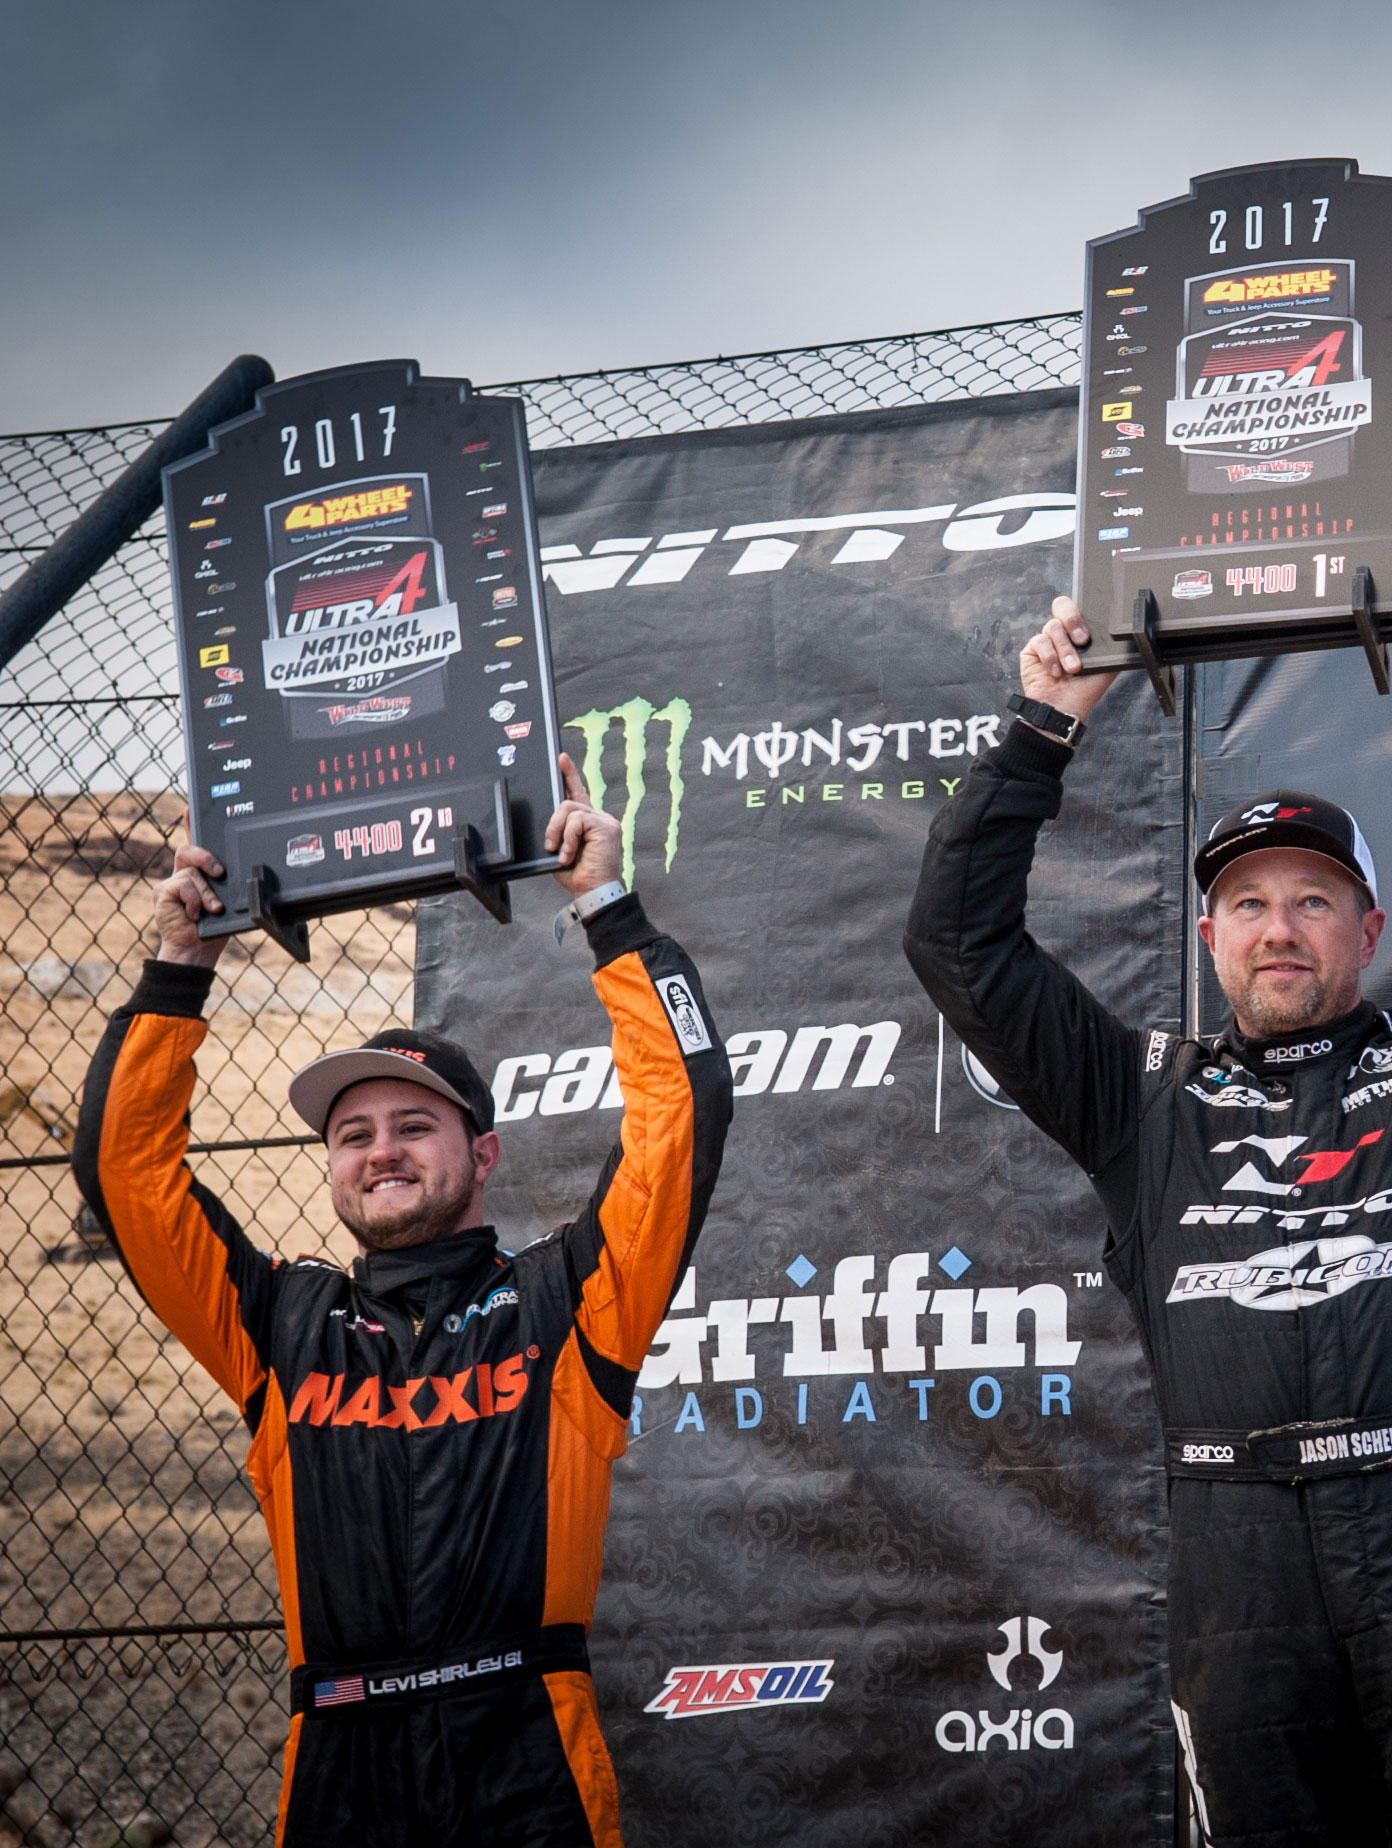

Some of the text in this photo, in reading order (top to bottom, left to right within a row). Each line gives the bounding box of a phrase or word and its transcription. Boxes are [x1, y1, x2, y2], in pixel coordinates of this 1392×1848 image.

[1209, 197, 1329, 254] 2017
[1203, 269, 1337, 303] 4 WHEEL
[1246, 281, 1330, 301] PARTS
[1227, 320, 1312, 336] NITTO
[1171, 403, 1368, 440] CHAMPIONSHIP
[1204, 391, 1333, 421] NATIONAL
[281, 406, 396, 476] 2017
[1248, 436, 1290, 452] 2017
[284, 485, 413, 531] 4 WHEEL
[326, 500, 408, 525] PARTS
[1113, 506, 1144, 518] Jeep
[1212, 502, 1322, 527] REGIONAL
[540, 492, 1077, 595] NITTO
[1180, 519, 1354, 547] CHAMPIONSHIP
[313, 543, 394, 566] NITTO
[1226, 553, 1345, 598] 4400 1ST
[270, 630, 457, 681] CHAMPIONSHIP
[300, 618, 423, 660] NATIONAL
[346, 671, 385, 692] 2017
[223, 757, 252, 772] Jeep
[319, 740, 424, 774] REGIONAL
[701, 714, 1000, 781] MONSTER
[291, 755, 456, 802] CHAMPIONSHIP
[746, 778, 962, 808] ENERGY
[334, 820, 403, 860] 4400
[1264, 1039, 1333, 1064] sparco
[288, 1353, 529, 1434] MAXXIS
[1181, 1443, 1235, 1464] sparco
[1298, 1433, 1350, 1464] JASON
[369, 1674, 417, 1695] LEVI
[418, 1657, 502, 1688] SHIRLEY
[650, 1662, 833, 1713] AMSOIL
